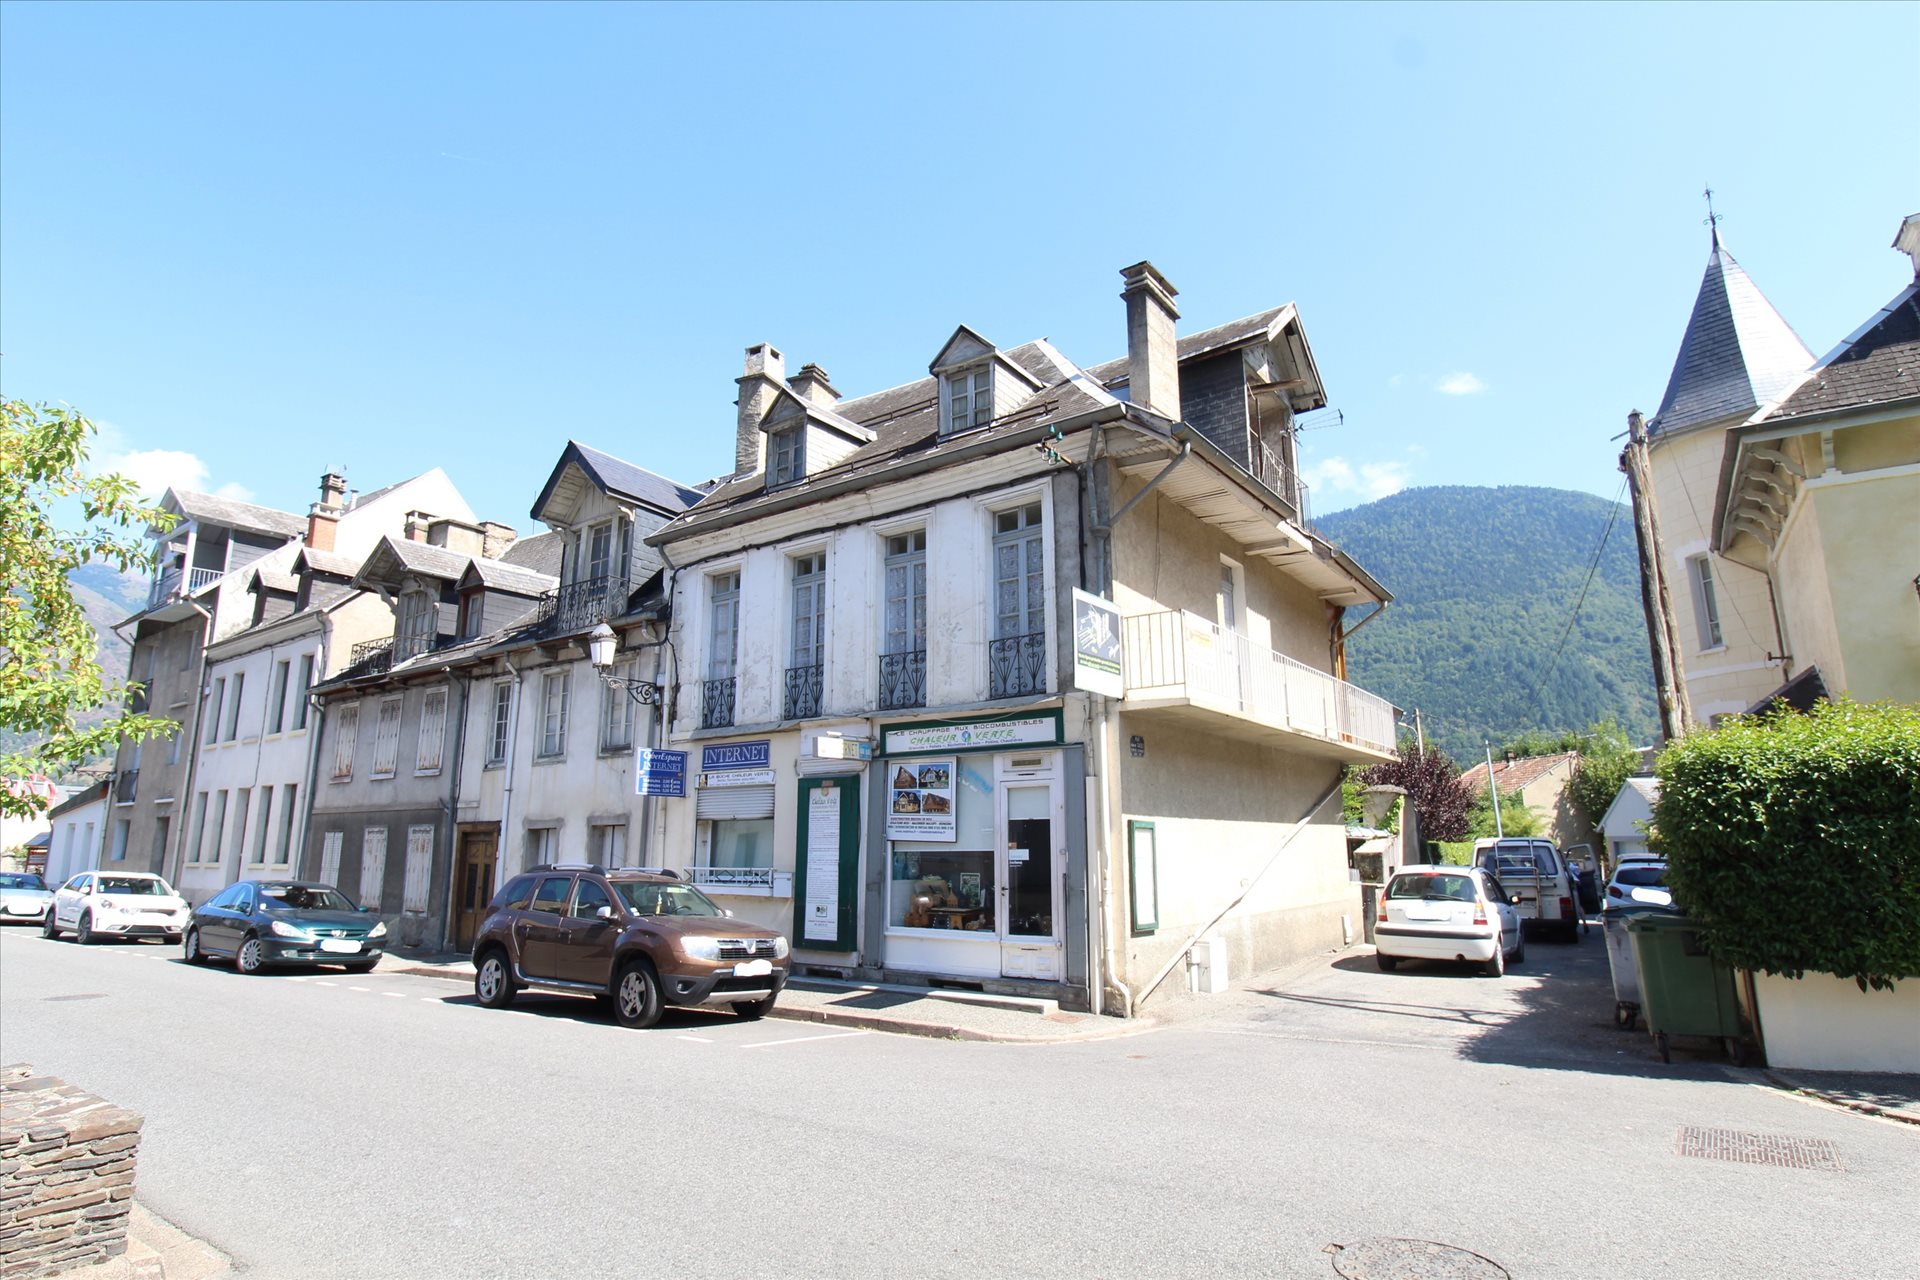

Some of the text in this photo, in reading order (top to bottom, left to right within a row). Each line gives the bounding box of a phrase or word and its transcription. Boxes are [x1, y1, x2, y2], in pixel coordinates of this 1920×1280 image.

[909, 727, 950, 735] CHAUFFAGE
[973, 719, 1044, 730] BIOCOMBUSTIBLES
[911, 729, 1015, 744] CHALEUR VERTE
[704, 744, 768, 764] INTERNET
[643, 761, 682, 771] INTERNET
